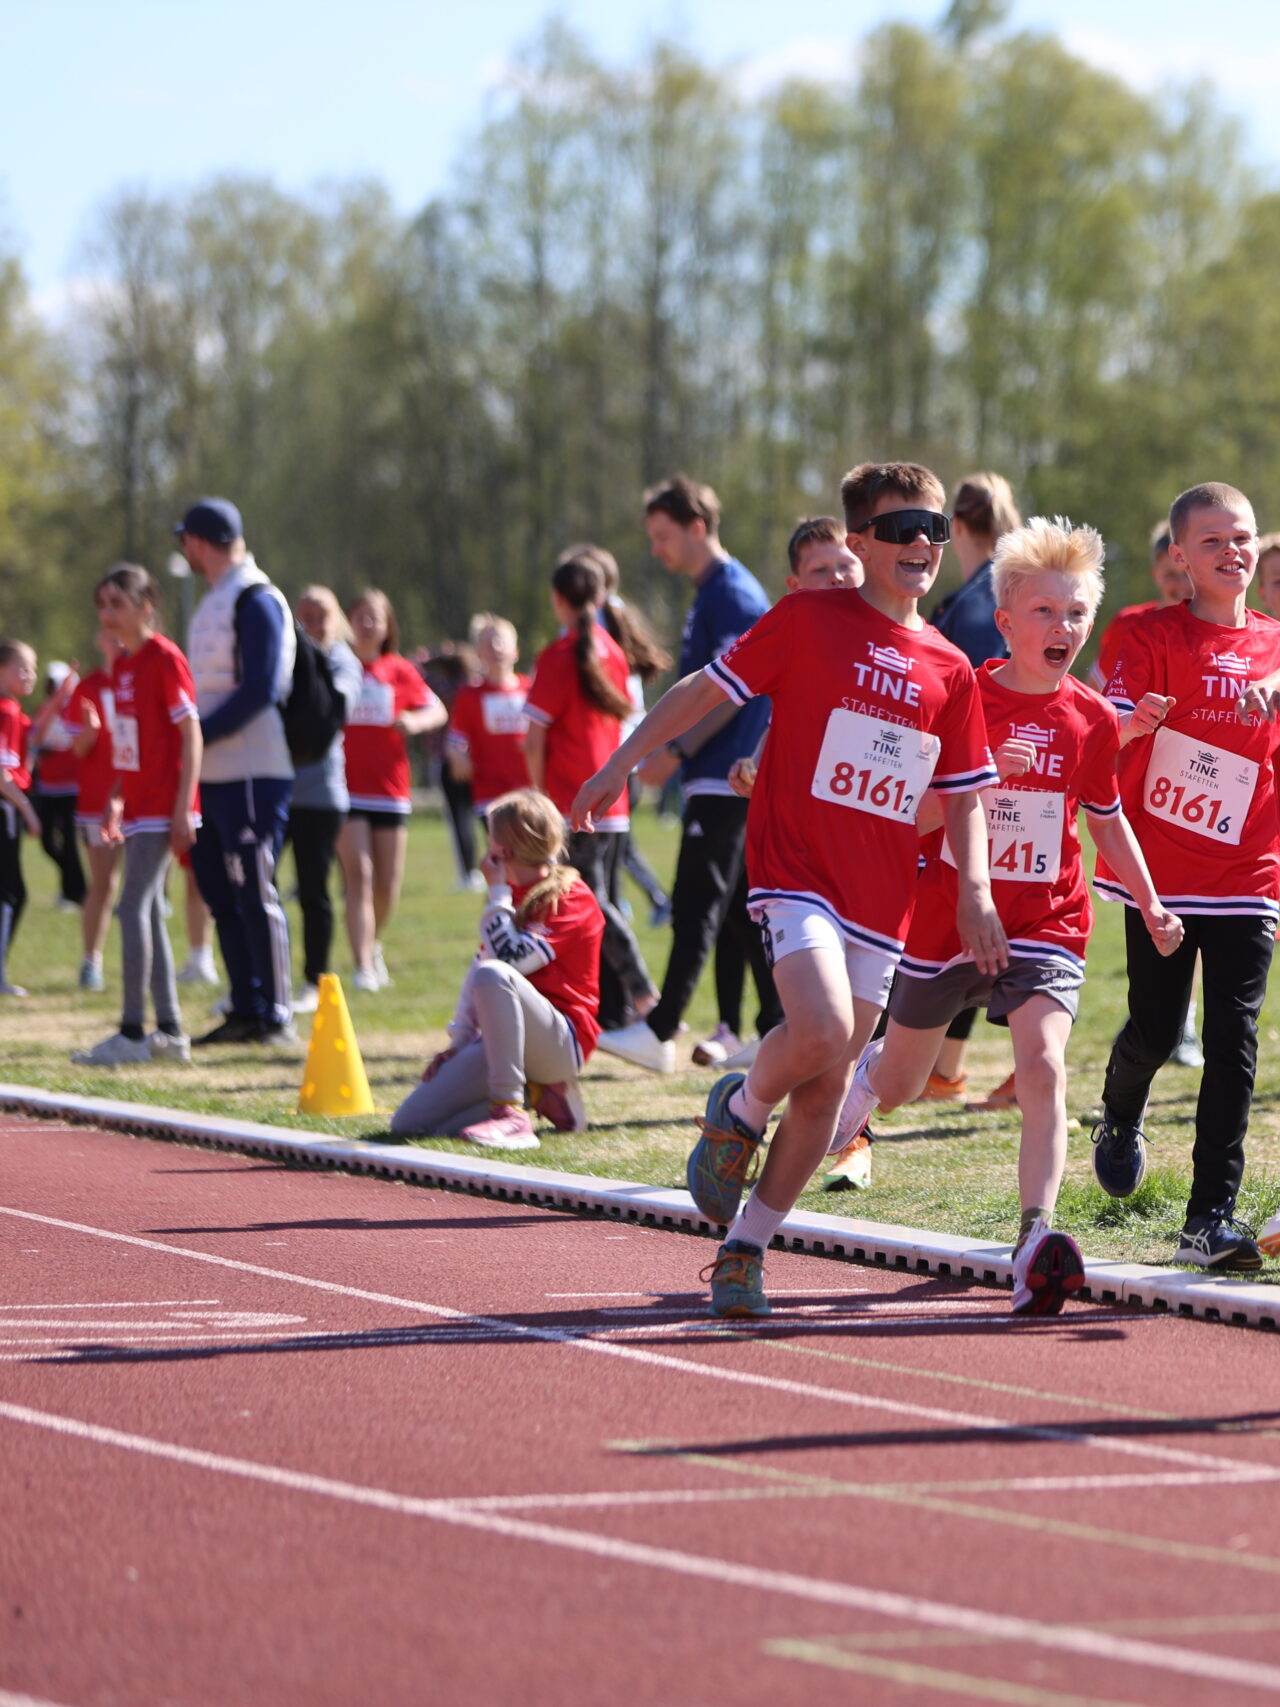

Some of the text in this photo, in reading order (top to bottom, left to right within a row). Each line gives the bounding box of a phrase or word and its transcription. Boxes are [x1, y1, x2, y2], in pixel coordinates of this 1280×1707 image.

[854, 662, 922, 708] TINE
[1201, 676, 1258, 699] TIN
[1191, 708, 1262, 729] STAFETEN
[873, 740, 902, 758] TINE
[1033, 753, 1064, 778] NE
[1189, 760, 1219, 779] TINE
[1180, 770, 1219, 790] STAFETTEN
[989, 809, 1022, 823] TINE
[987, 823, 1026, 832] TAFETTEN
